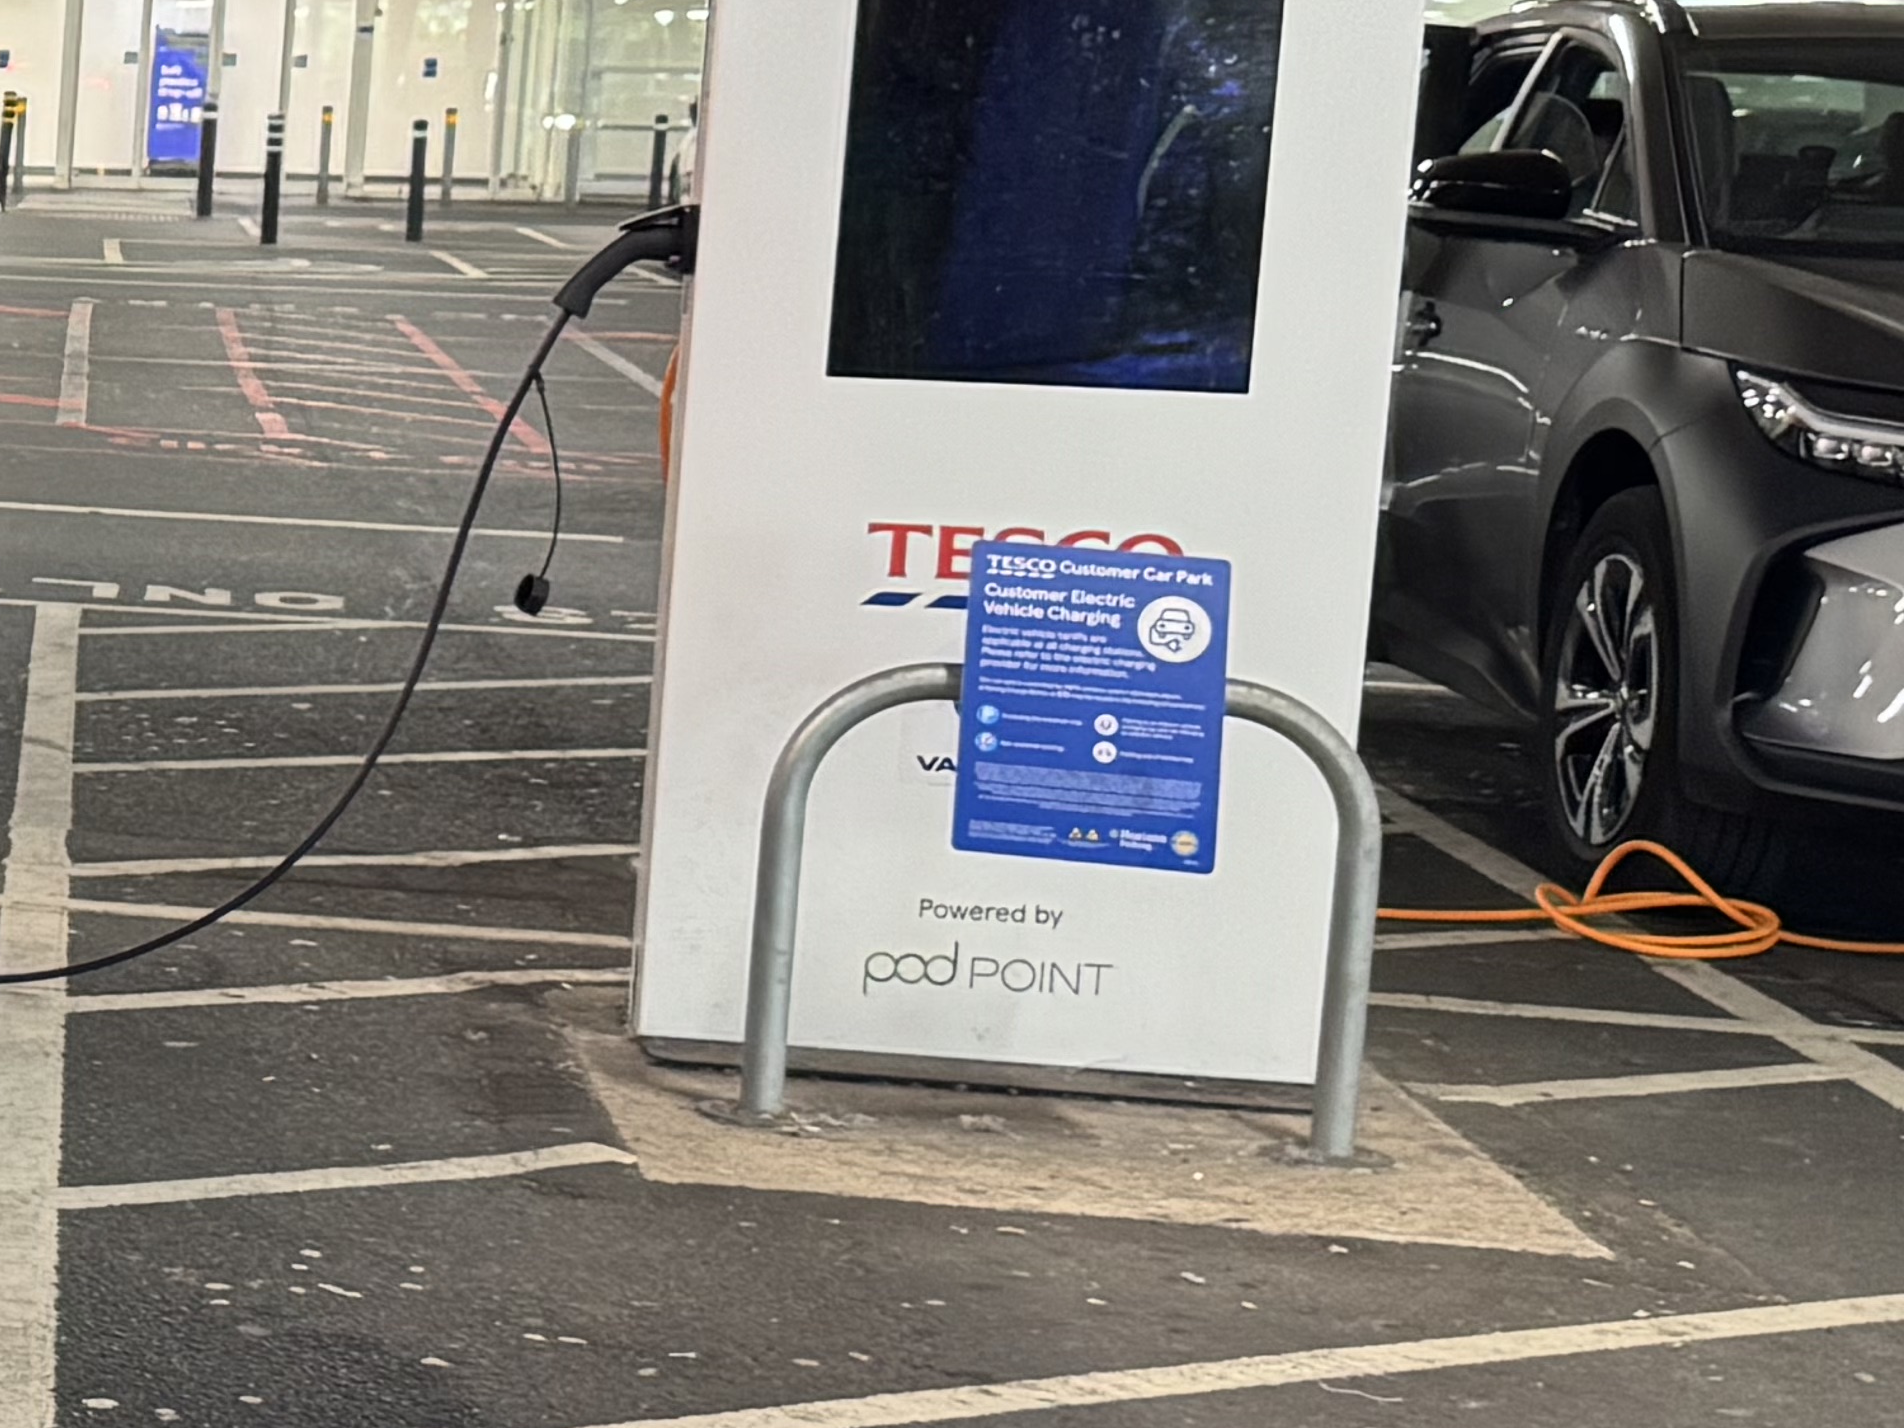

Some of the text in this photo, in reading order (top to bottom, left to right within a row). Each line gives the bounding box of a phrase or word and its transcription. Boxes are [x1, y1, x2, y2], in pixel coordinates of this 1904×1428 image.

[986, 554, 1214, 586] TESCO Customer Car Park
[984, 583, 1135, 609] Customer Electric
[983, 600, 1121, 629] Vehicle Charging
[919, 898, 1063, 929] Powered by
[863, 940, 1113, 996] pod POINT
